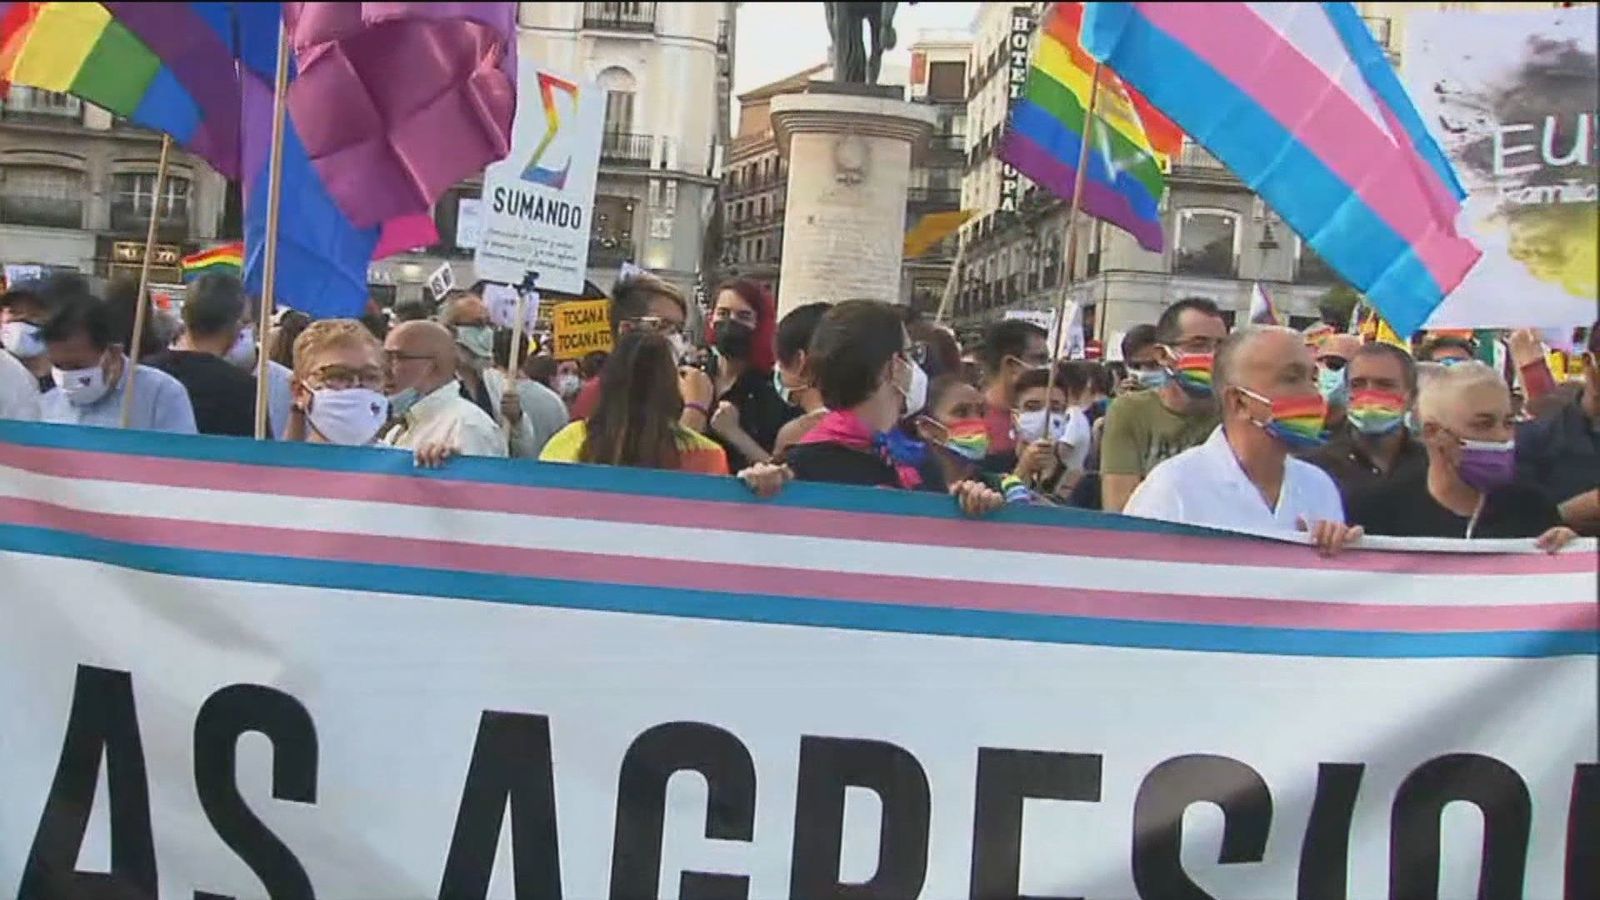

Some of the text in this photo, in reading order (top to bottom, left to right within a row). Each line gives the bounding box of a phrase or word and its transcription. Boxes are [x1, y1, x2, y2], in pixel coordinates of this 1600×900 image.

[1001, 16, 1030, 212] HOTEL OPA
[1493, 111, 1598, 176] EU
[493, 186, 582, 230] SUMANDO
[17, 664, 1598, 899] AS AGRESIO
